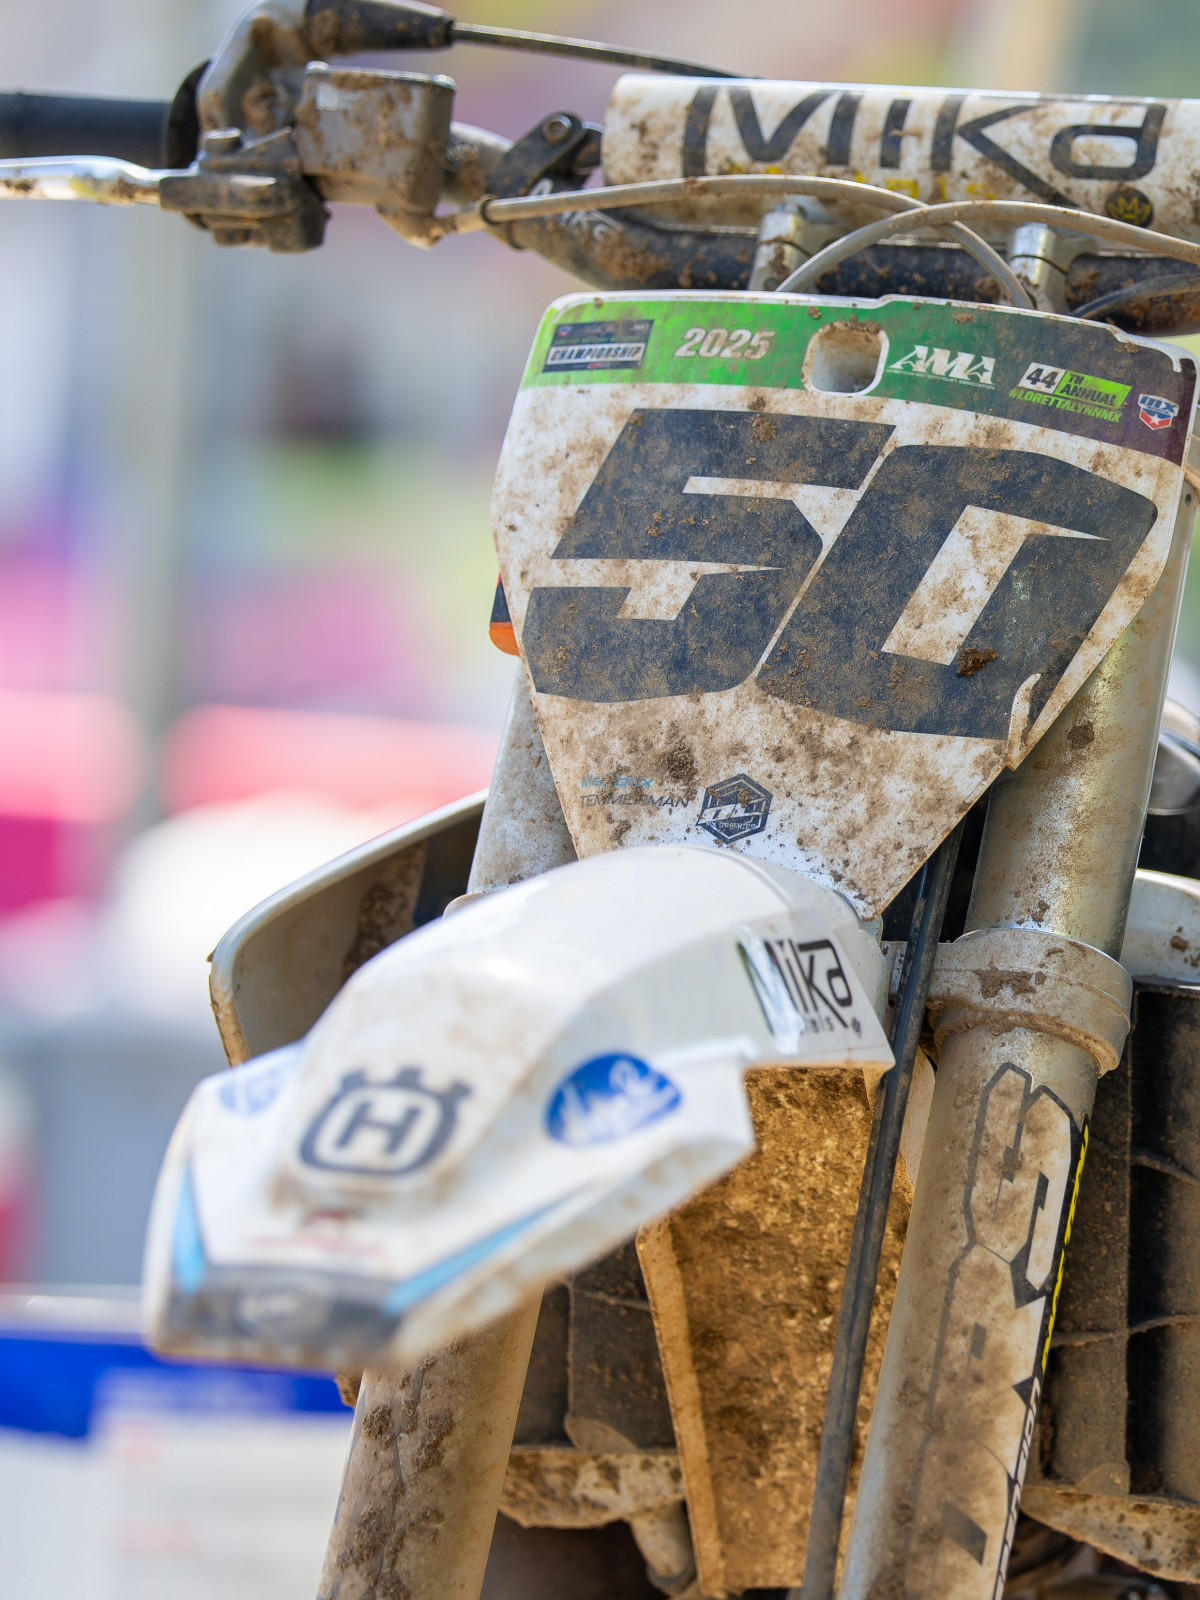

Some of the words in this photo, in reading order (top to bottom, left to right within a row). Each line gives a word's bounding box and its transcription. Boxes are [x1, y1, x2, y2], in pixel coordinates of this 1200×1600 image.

[550, 346, 642, 363] CHAMPIONSHIP
[673, 327, 776, 361] 2025
[888, 344, 996, 385] AMA
[1025, 367, 1059, 390] 44
[1008, 387, 1123, 423] #LORETTALYNNMX
[1059, 383, 1119, 407] ANNUAL
[522, 407, 1159, 741] 50
